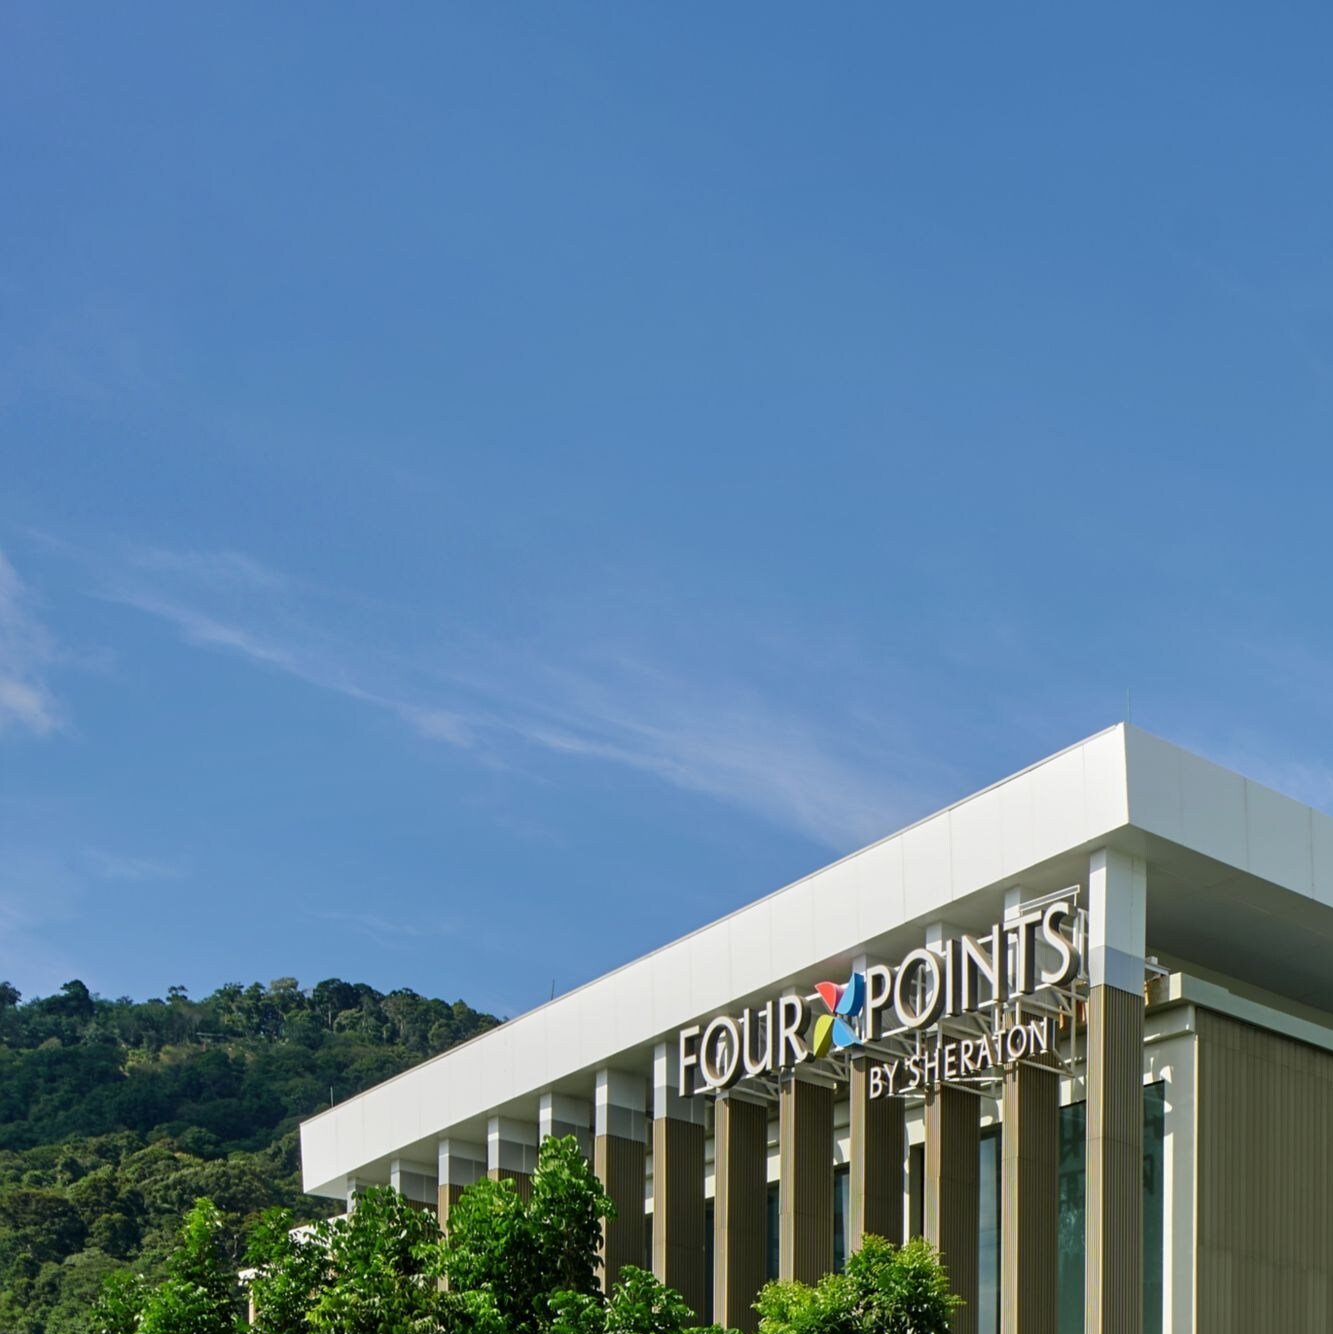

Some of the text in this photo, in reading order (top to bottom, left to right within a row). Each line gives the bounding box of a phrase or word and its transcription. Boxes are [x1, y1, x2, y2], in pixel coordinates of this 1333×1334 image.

[679, 901, 1080, 1097] FOUR POINTS
[870, 1016, 1054, 1099] BY SHERATON
